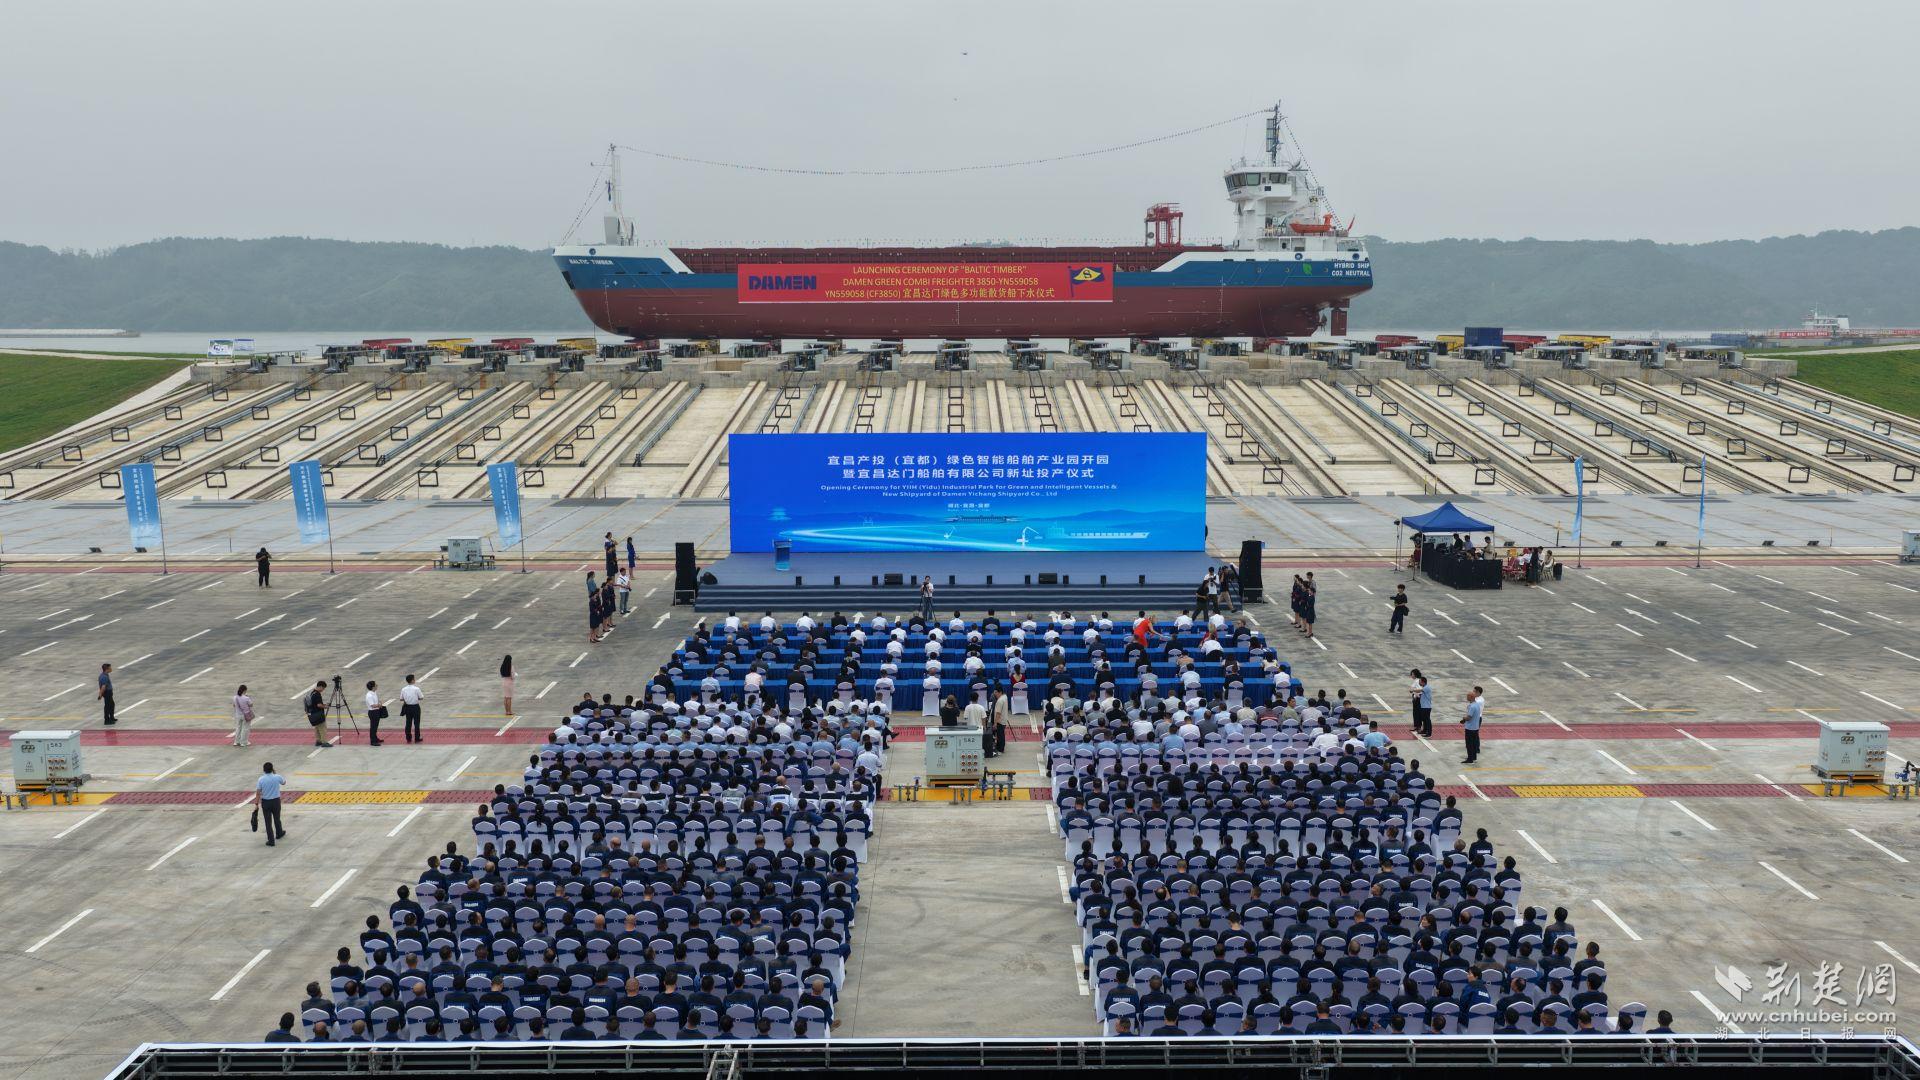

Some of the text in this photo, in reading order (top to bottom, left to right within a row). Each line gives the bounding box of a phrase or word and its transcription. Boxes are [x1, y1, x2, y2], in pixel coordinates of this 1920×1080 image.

[853, 265, 1027, 274] LAUNCHING CEREMONY OF "BALTIC TIMBER"
[748, 275, 817, 290] DAMEN
[843, 278, 873, 286] DAMEN
[874, 278, 901, 286] GREEN
[903, 278, 931, 286] COMBI
[932, 278, 975, 286] FREIGHTER
[825, 289, 865, 298] YN559058
[866, 289, 901, 299] (CF3850)
[843, 468, 1094, 479] 暨宜昌达门船舶有限公司新址投产仪式
